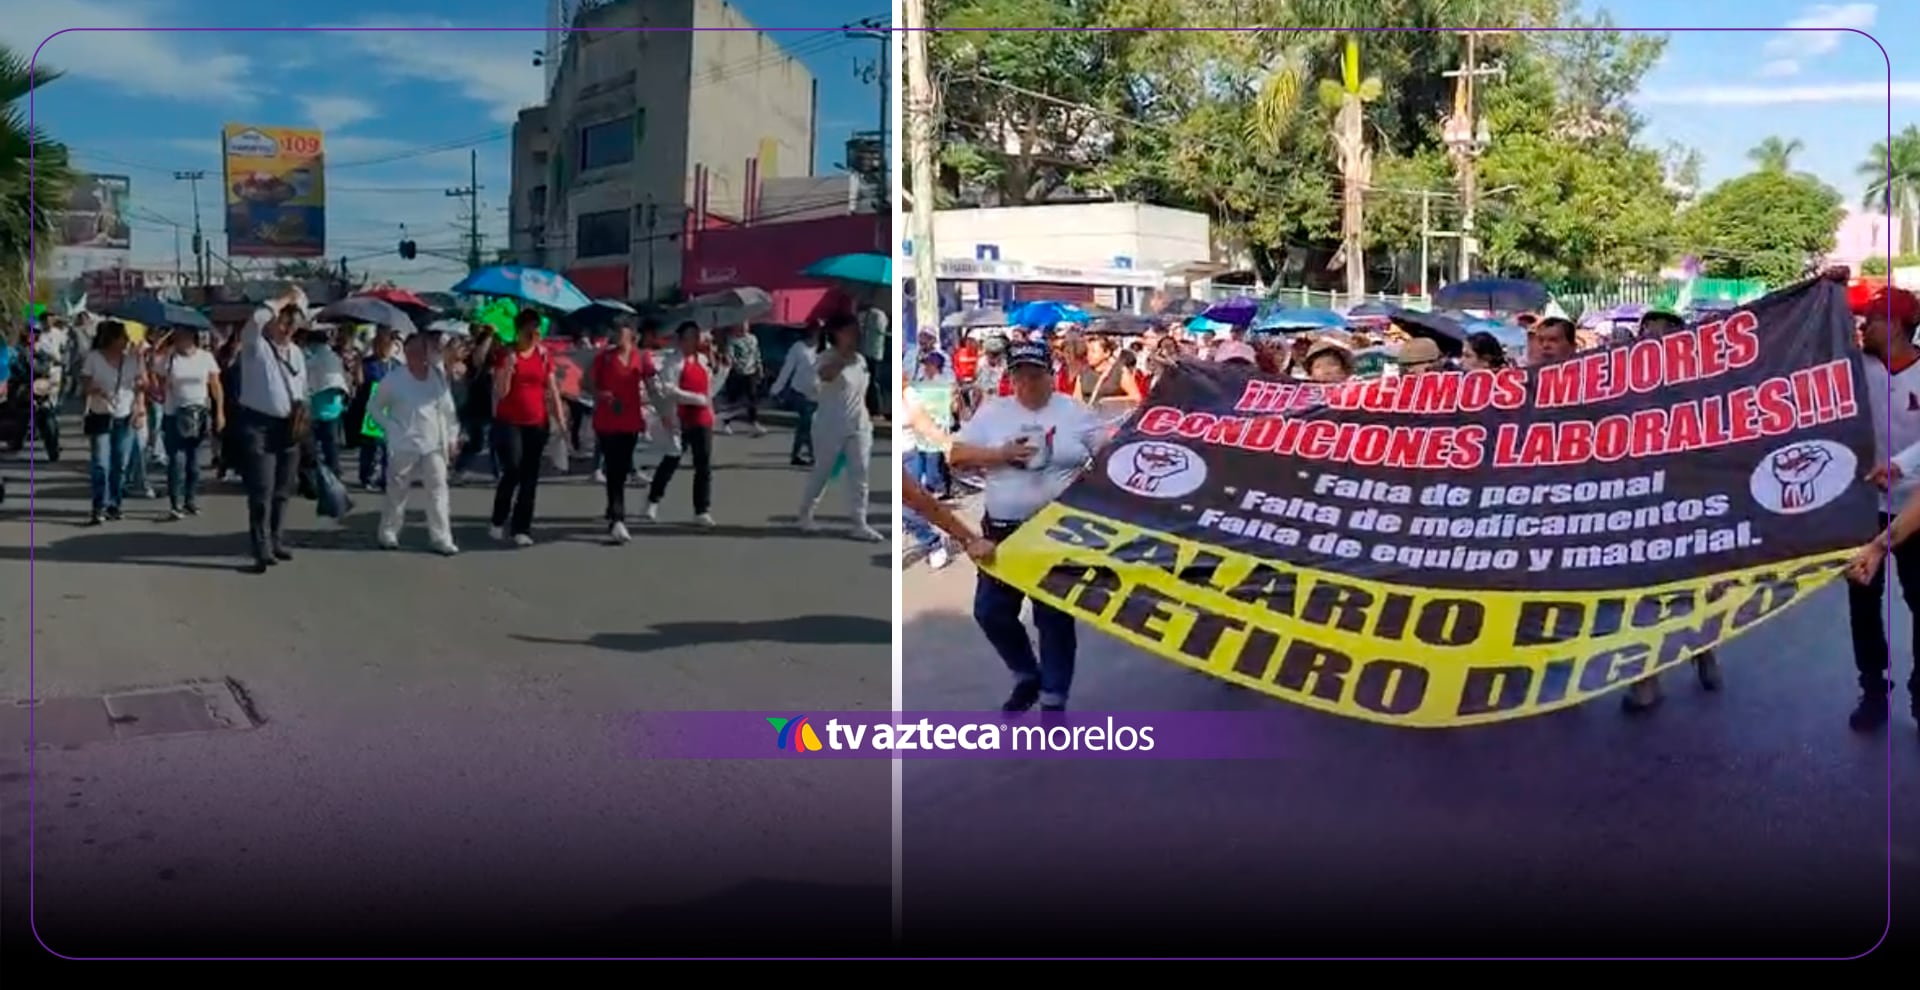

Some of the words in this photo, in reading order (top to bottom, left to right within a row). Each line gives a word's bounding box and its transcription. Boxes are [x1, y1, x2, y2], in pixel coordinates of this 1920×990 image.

[1535, 310, 1758, 408] MEJORES
[1137, 406, 1487, 469] CONDICIONES
[1493, 358, 1857, 468] LABORALES!!!
[1240, 489, 1341, 526] Falta
[1349, 507, 1402, 533] de
[1409, 494, 1729, 538] medicamentos
[1313, 473, 1413, 504] Falta
[1420, 483, 1472, 506] de
[1479, 470, 1666, 508] personal
[1045, 515, 1486, 646] SALARIO
[1198, 508, 1301, 546] Falta
[1308, 532, 1362, 558] de
[1371, 543, 1518, 572] equipo
[1526, 547, 1553, 572] y
[1561, 520, 1763, 569] material.
[1037, 558, 1430, 714] RETIRO
[1456, 581, 1798, 715] DIGNO
